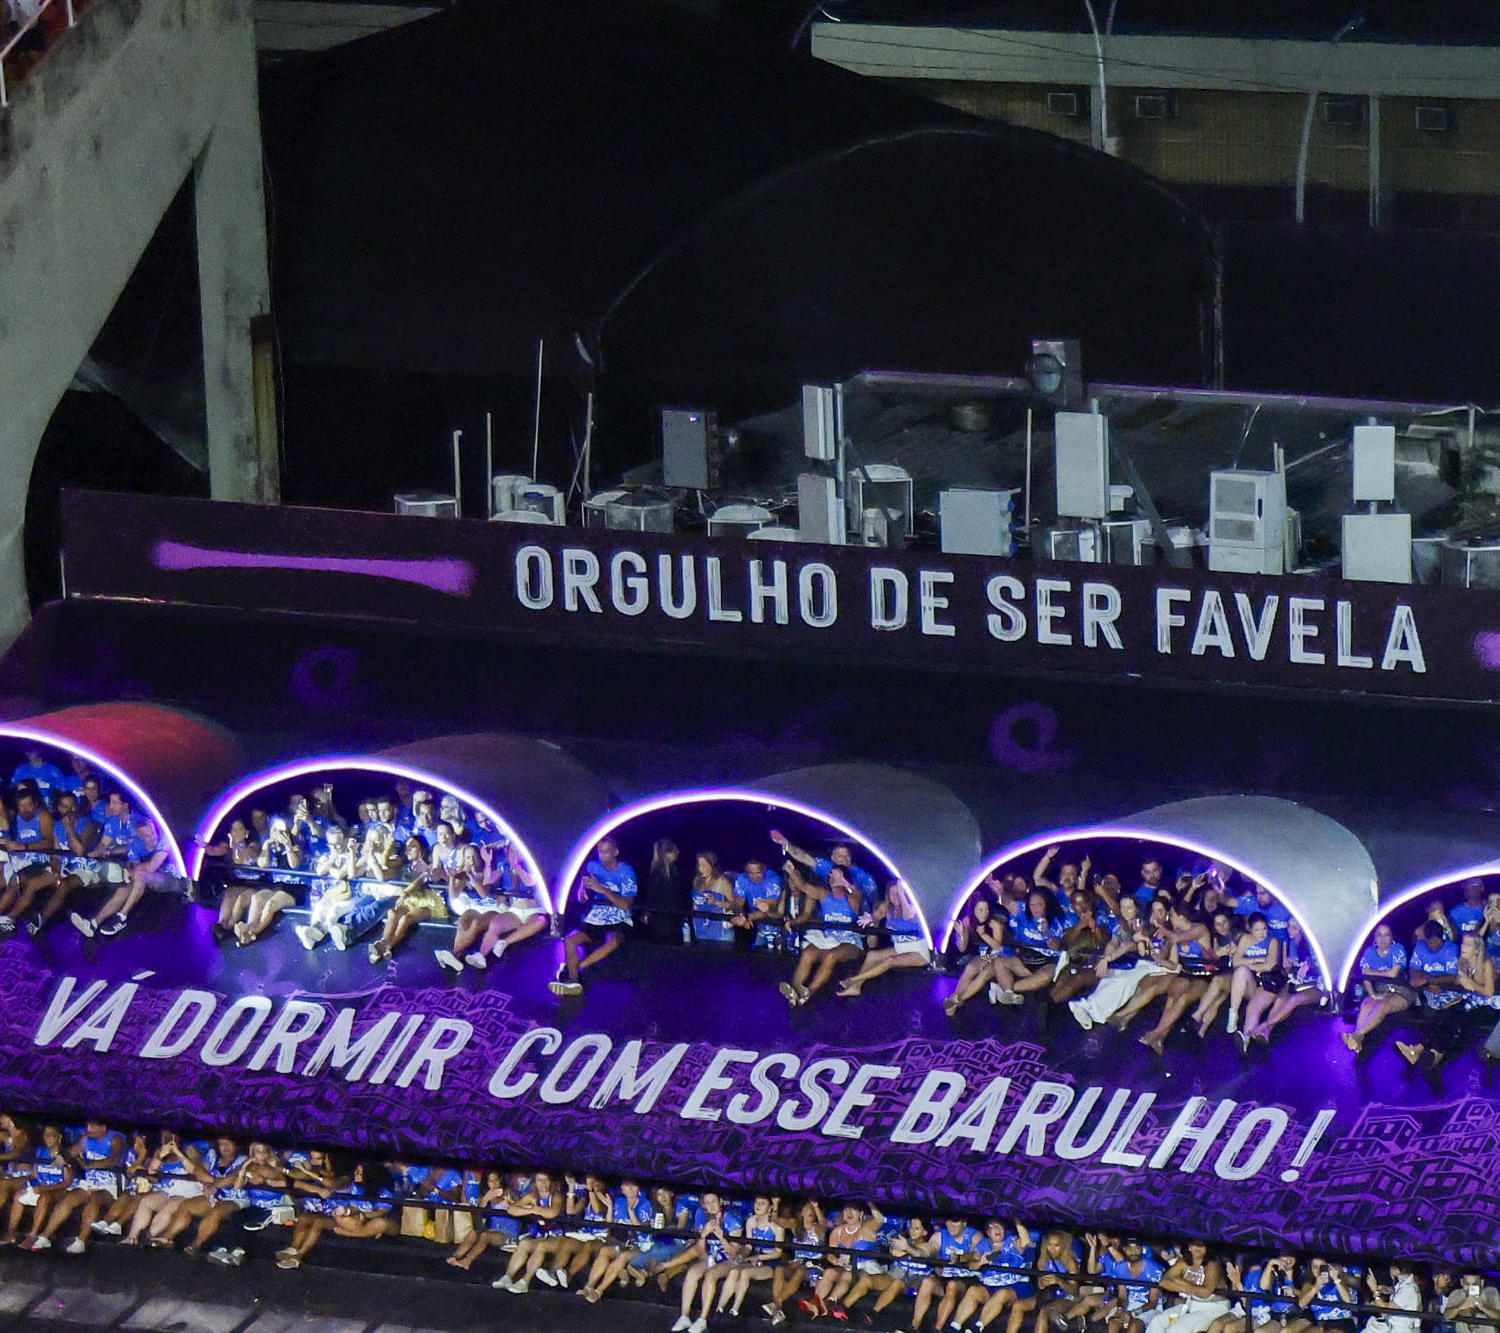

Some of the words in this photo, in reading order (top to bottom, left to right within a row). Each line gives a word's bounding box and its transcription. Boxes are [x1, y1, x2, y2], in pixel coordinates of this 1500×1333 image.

[516, 545, 838, 628] ORGULHO
[870, 567, 955, 637] DE
[986, 576, 1124, 650] SER
[1156, 588, 1427, 673] FAVELA
[35, 969, 157, 1053] VÁ
[140, 988, 473, 1090] DORMIR
[489, 1028, 690, 1113] COM
[680, 1048, 901, 1138] ESSE
[890, 1070, 1336, 1182] BARULHO!
